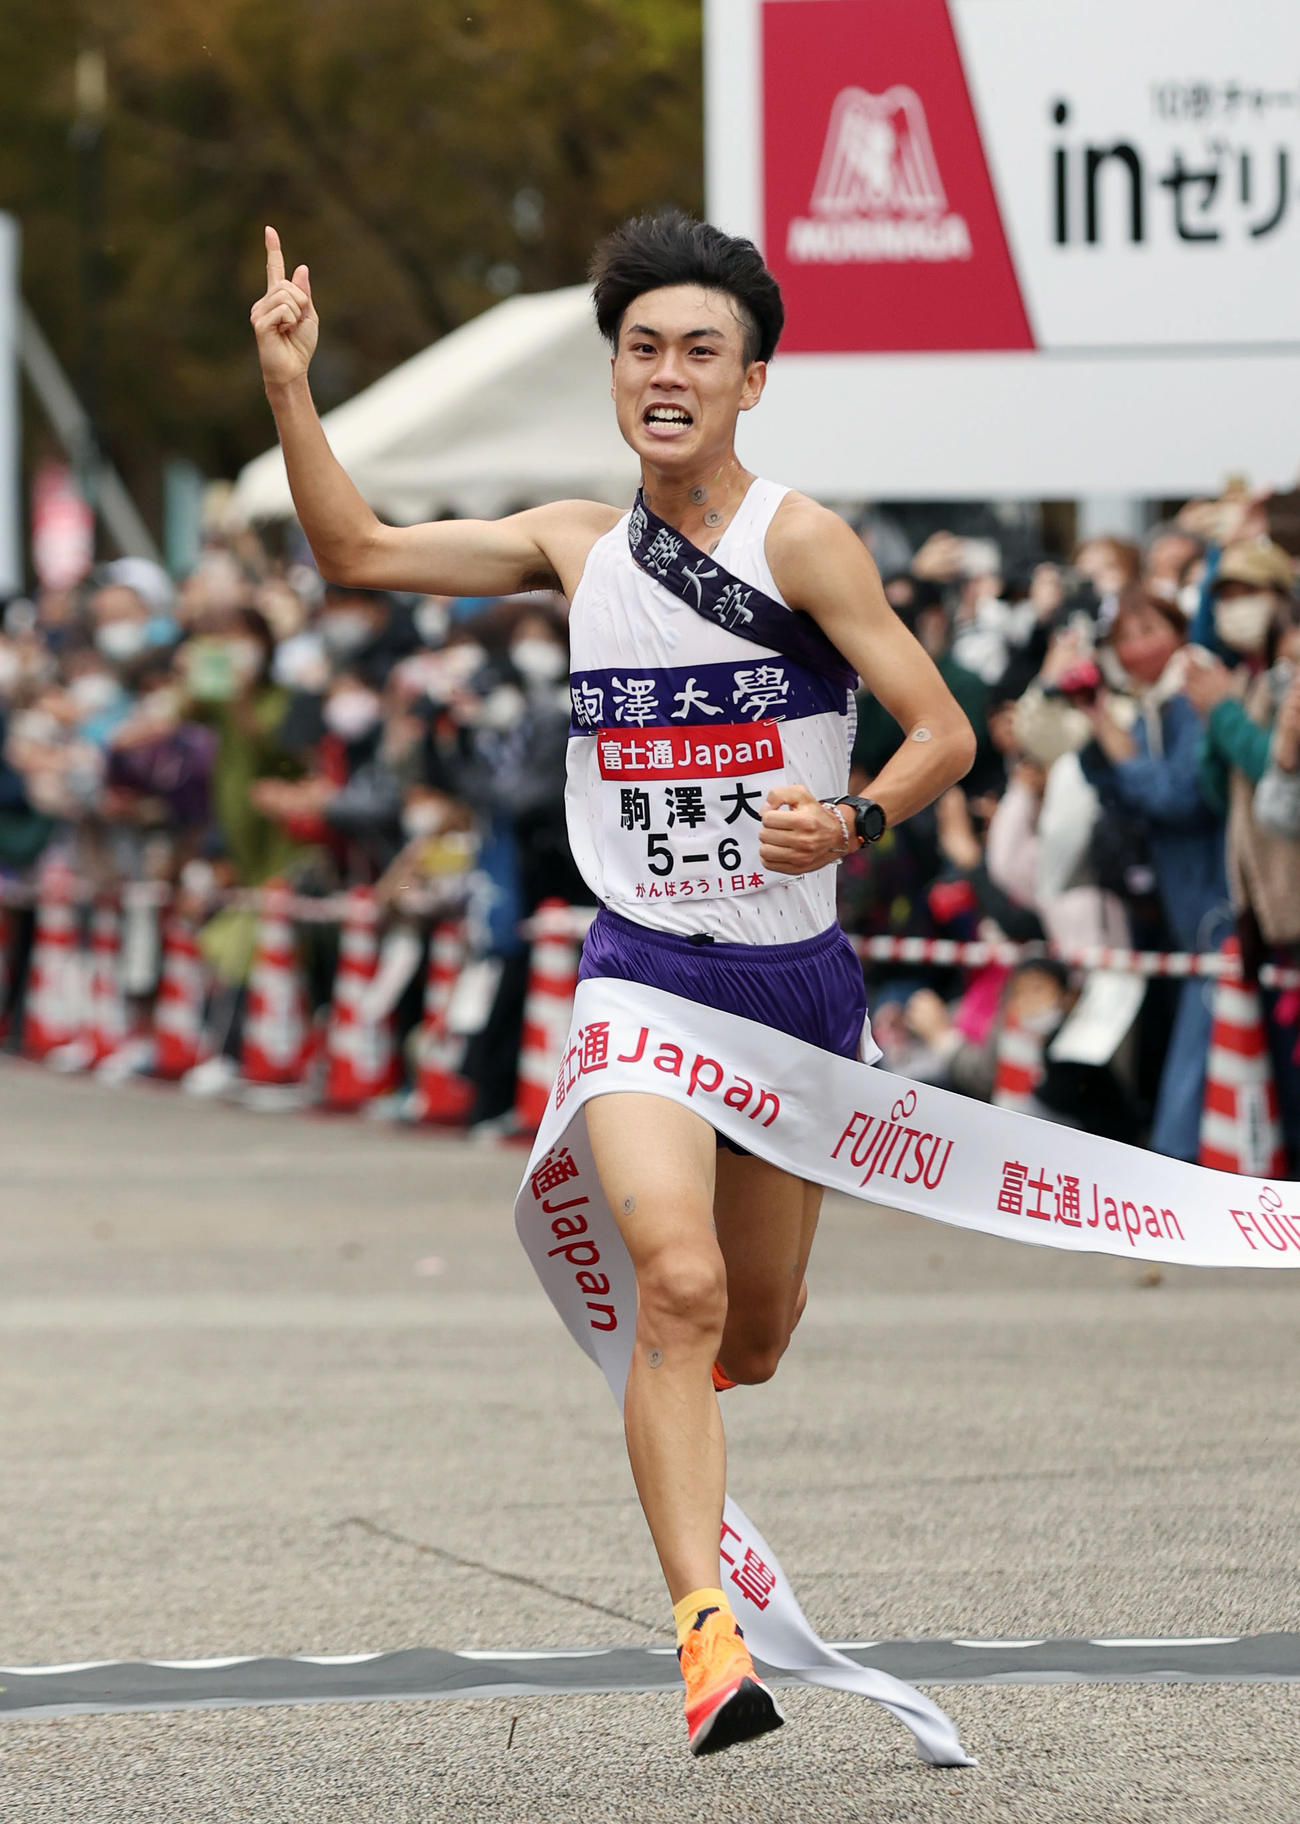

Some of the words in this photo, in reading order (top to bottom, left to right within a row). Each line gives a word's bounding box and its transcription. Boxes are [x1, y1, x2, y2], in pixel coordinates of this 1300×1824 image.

[1051, 99, 1300, 245] inゼリ
[600, 739, 774, 773] 富士通Japan
[620, 782, 763, 831] 駒澤大
[831, 1108, 953, 1189] FUJITSU
